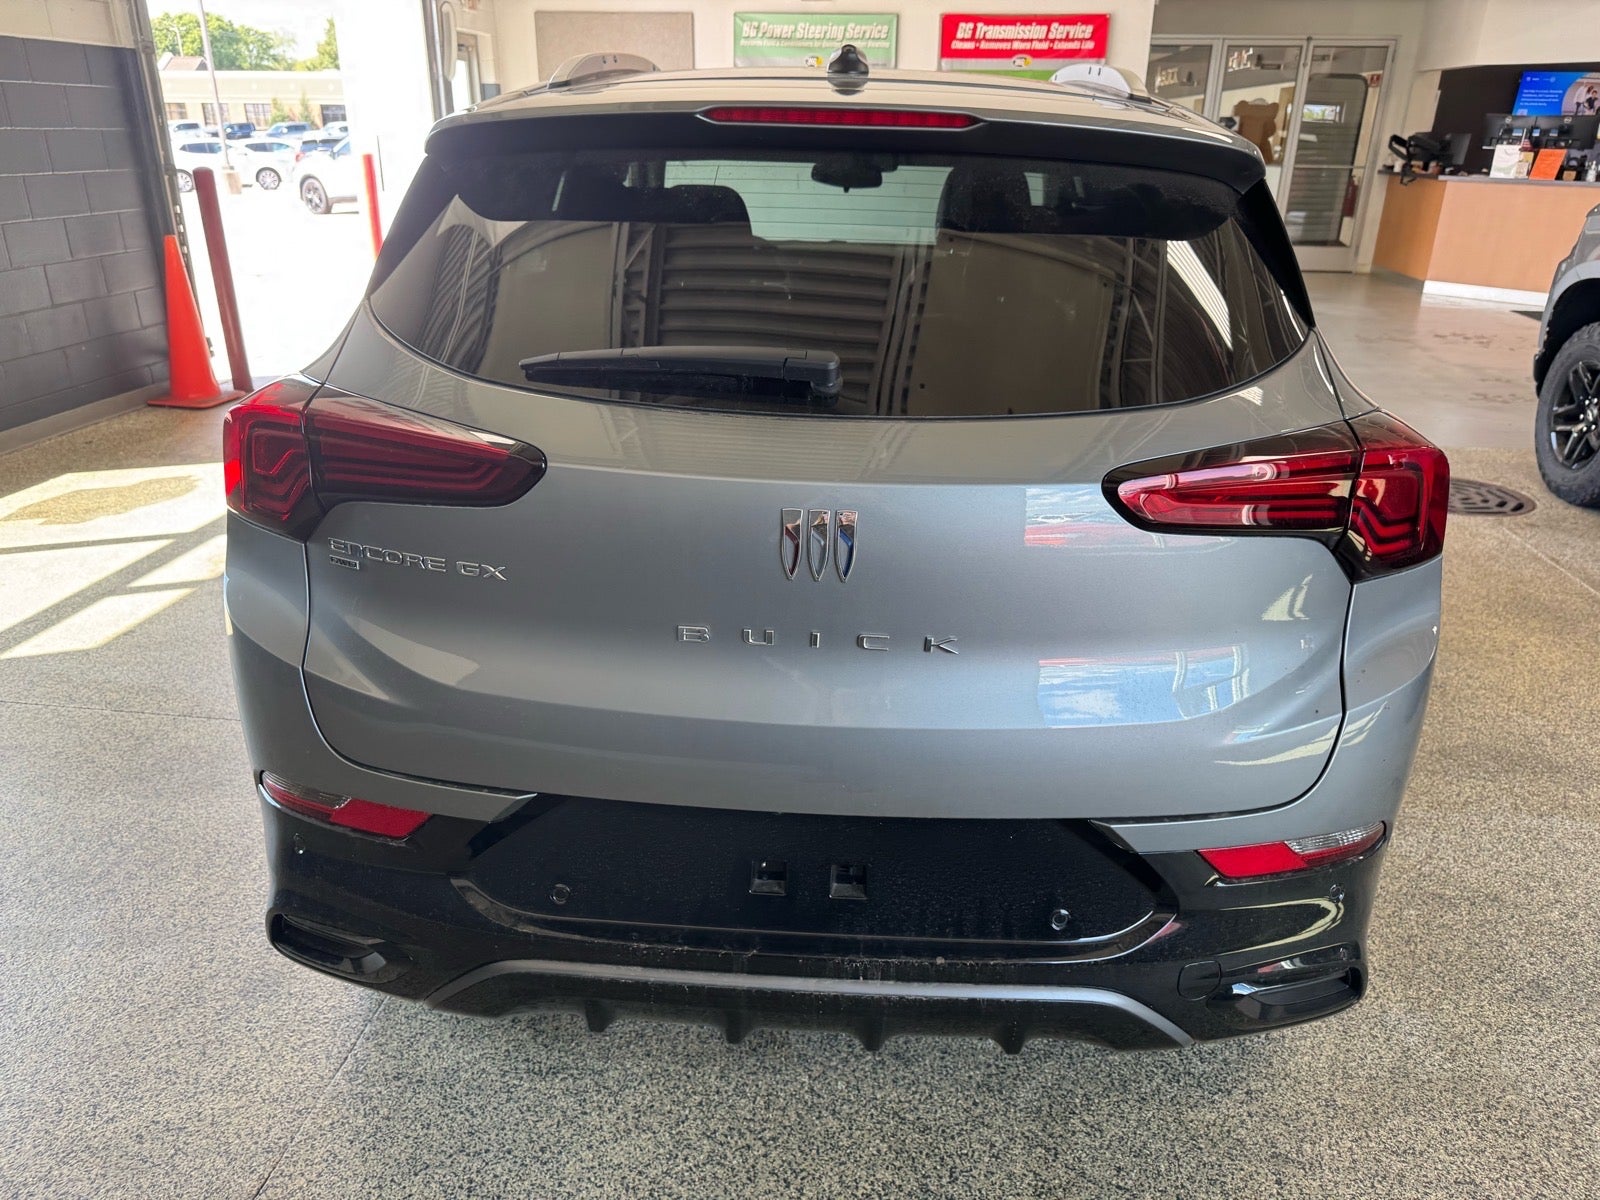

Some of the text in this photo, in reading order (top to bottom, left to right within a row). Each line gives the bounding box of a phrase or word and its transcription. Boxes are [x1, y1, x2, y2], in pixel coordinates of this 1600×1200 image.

[759, 22, 795, 39] Power
[796, 22, 845, 41] Steering
[845, 23, 890, 40] Service
[975, 22, 1048, 39] Transmission
[1048, 22, 1093, 39] Service
[328, 537, 507, 581] ENCORE GX
[677, 625, 959, 655] BUICK
